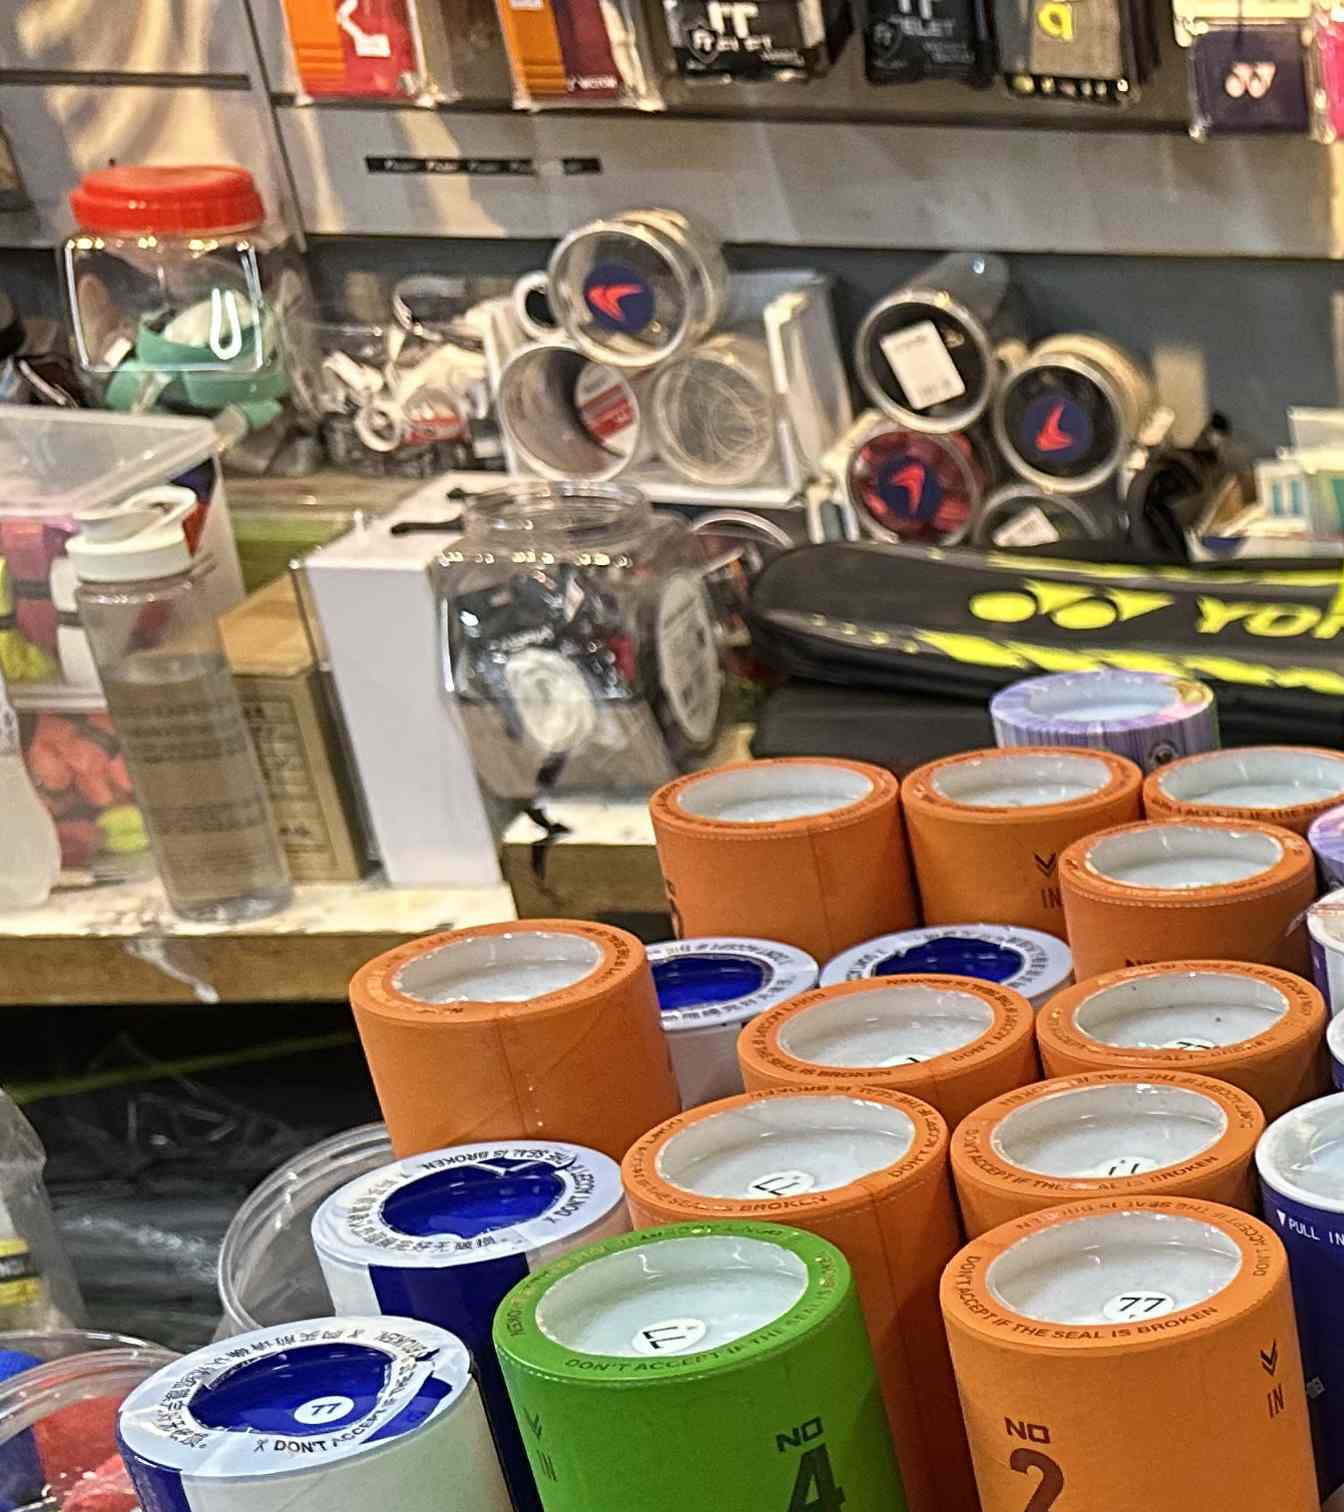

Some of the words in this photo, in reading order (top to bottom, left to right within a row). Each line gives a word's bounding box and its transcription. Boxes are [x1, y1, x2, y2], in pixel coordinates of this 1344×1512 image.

[970, 1153, 1013, 1183] ACCEPT
[1012, 1175, 1026, 1186] IF
[1148, 1155, 1219, 1186] BROKEN
[1287, 1217, 1320, 1242] PULL
[954, 1284, 999, 1328] ACCEPT
[993, 1317, 1009, 1333] IF
[1011, 1321, 1050, 1339] THE
[1051, 1327, 1101, 1341] SEAL
[1111, 1326, 1132, 1340] IS
[1135, 1306, 1220, 1337] BROKEN
[1118, 1297, 1166, 1315] 77
[564, 1357, 629, 1375] DON'T
[307, 1400, 343, 1418] 77
[1265, 1383, 1285, 1421] IN
[775, 1416, 825, 1453] NO
[1003, 1415, 1051, 1445] NO
[273, 1434, 329, 1456] DON'T
